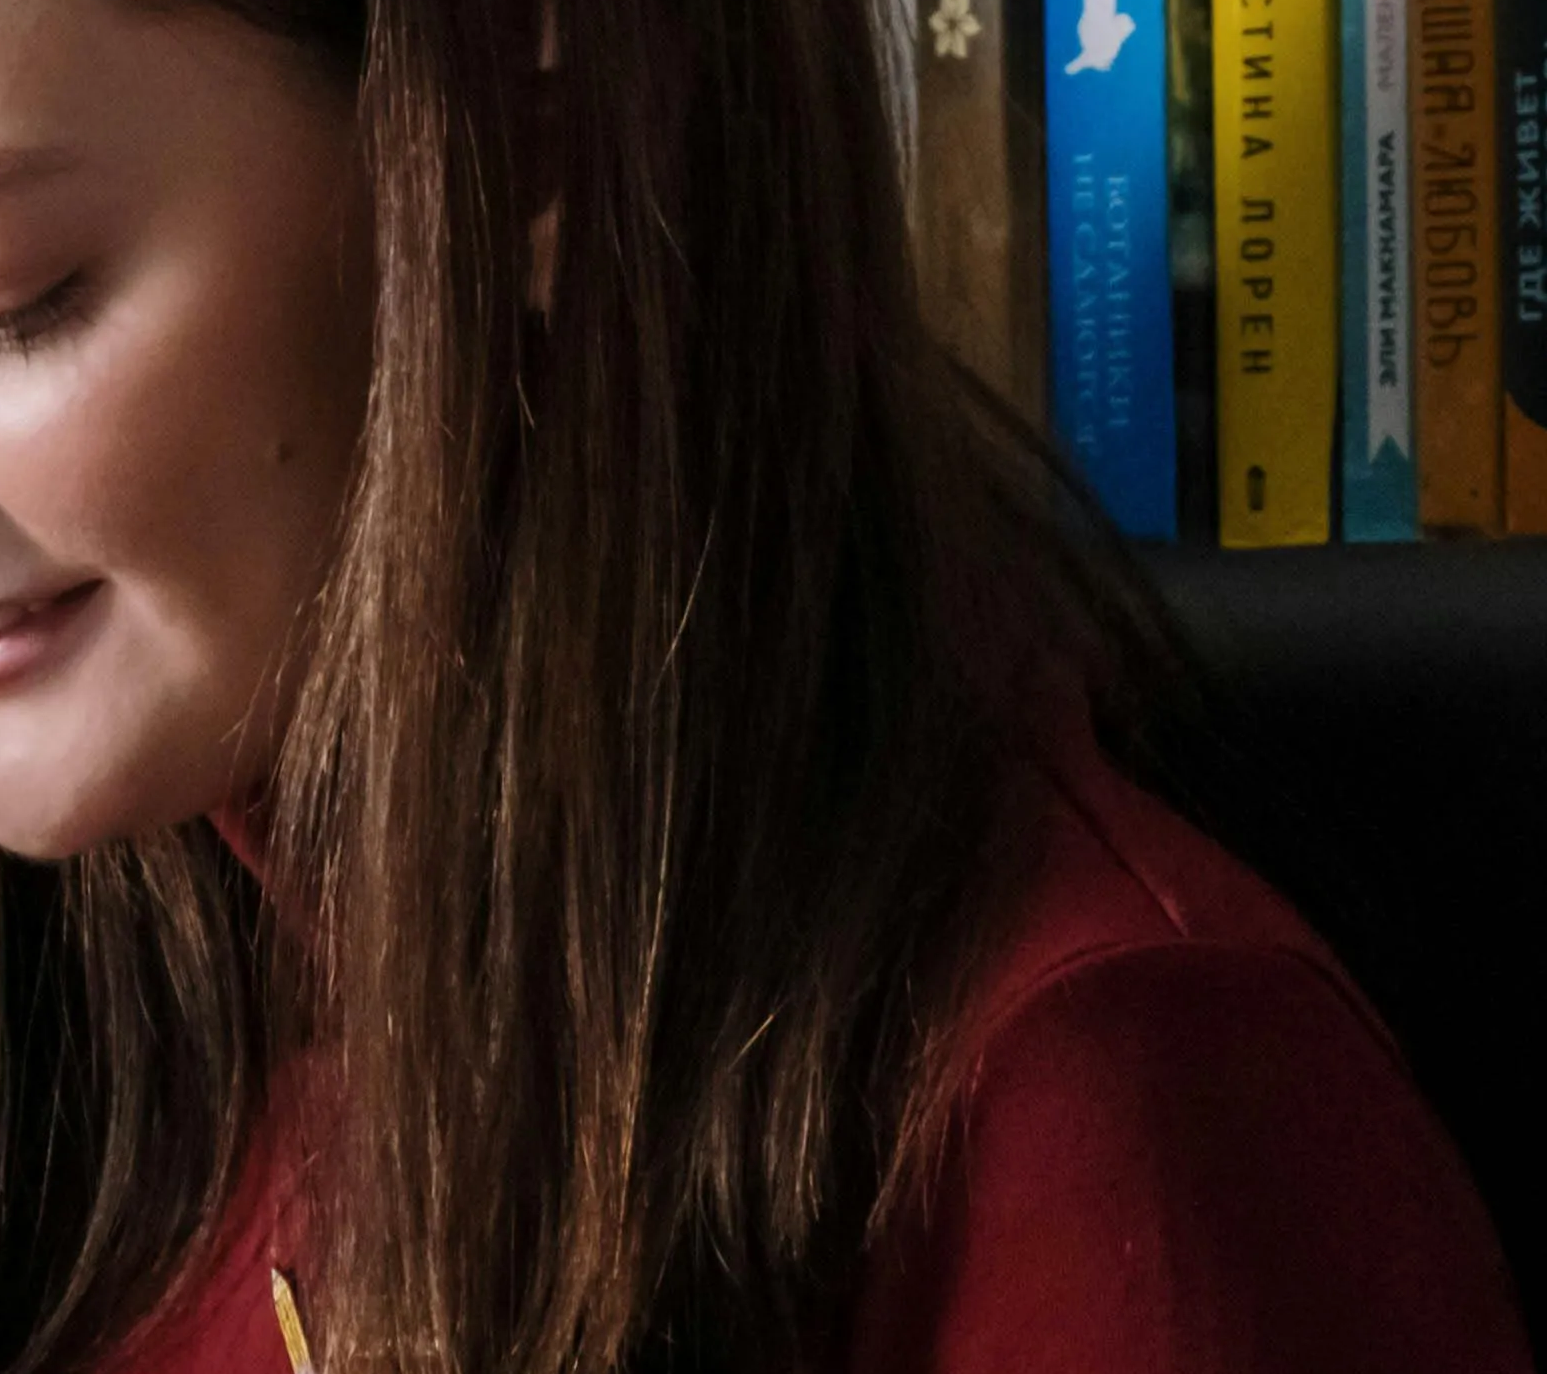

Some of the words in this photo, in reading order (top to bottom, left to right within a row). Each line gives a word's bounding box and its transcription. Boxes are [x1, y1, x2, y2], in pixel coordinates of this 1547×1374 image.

[1376, 130, 1396, 322] МАКНАМАРА
[1514, 71, 1541, 228] ЖИВЕТ
[1239, 196, 1276, 376] ЛОРЕН
[1516, 246, 1547, 322] ГДЕ
